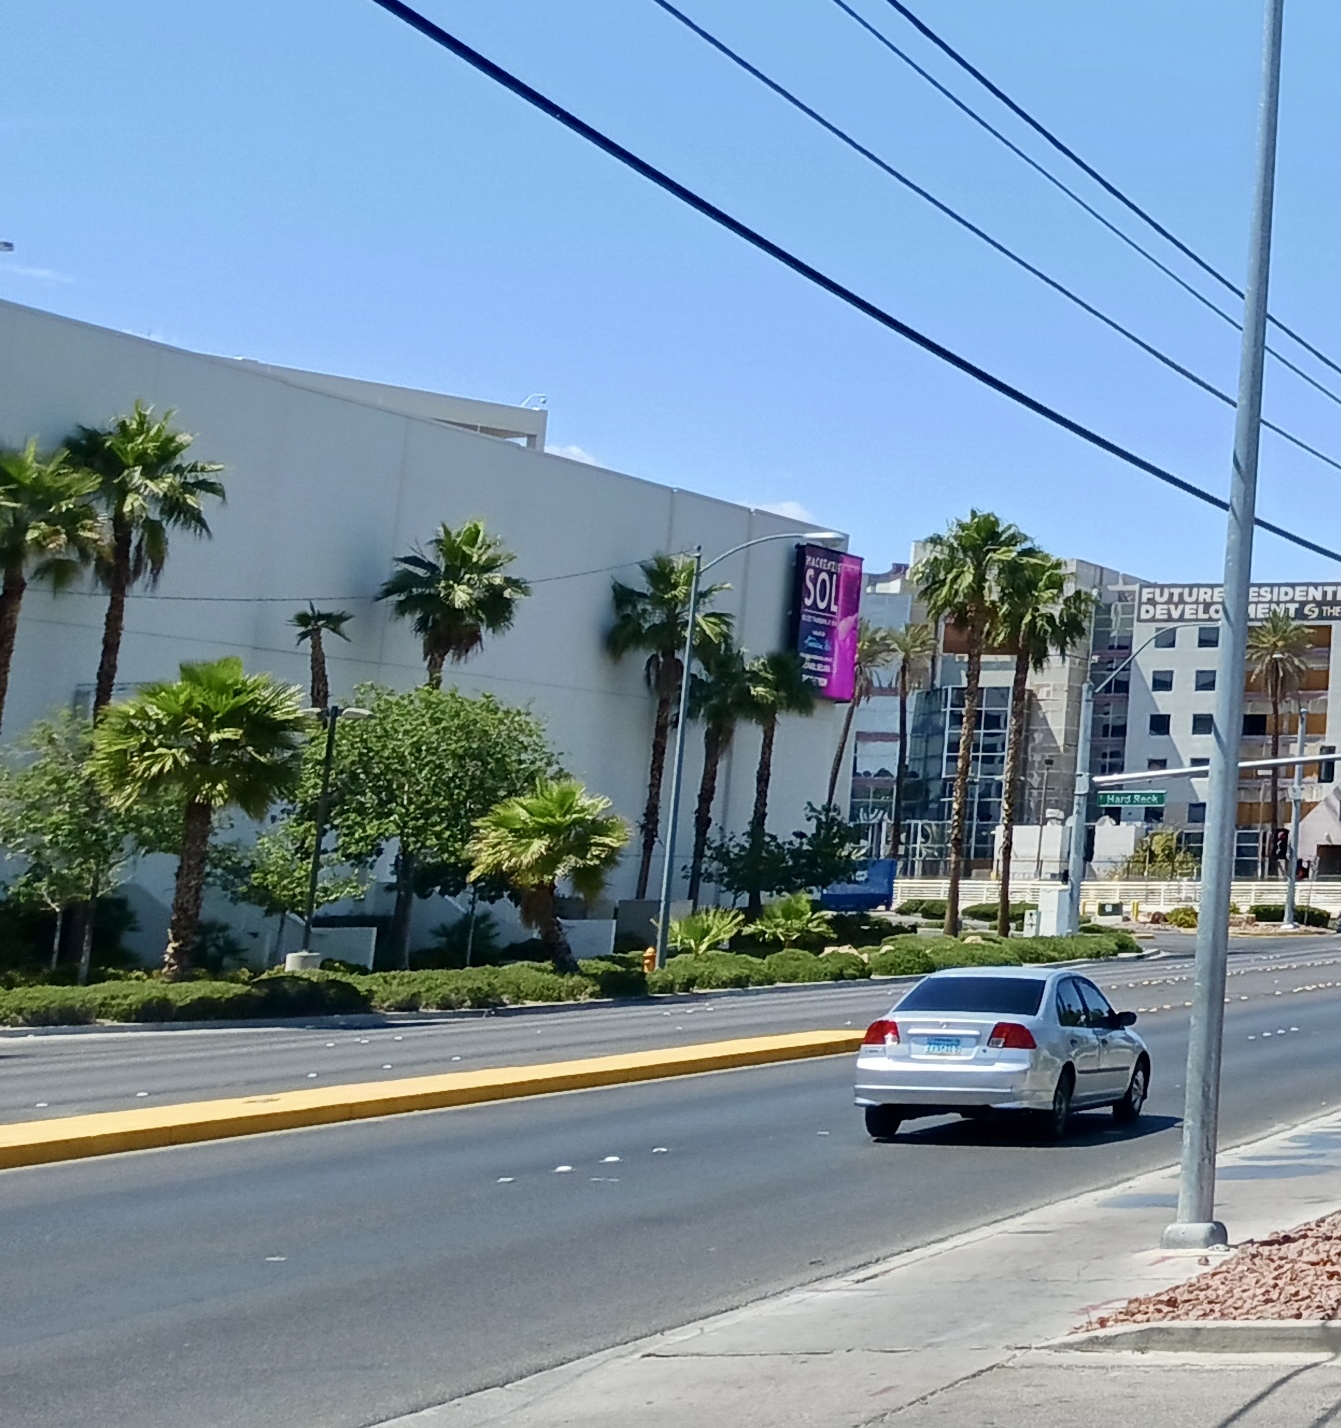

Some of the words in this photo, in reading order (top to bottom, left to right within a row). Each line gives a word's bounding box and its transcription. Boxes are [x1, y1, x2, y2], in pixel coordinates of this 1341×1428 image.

[804, 568, 838, 612] SOL
[1141, 586, 1225, 603] FUTURE
[1140, 603, 1299, 620] DEVELOENT
[1106, 794, 1132, 804] Hard
